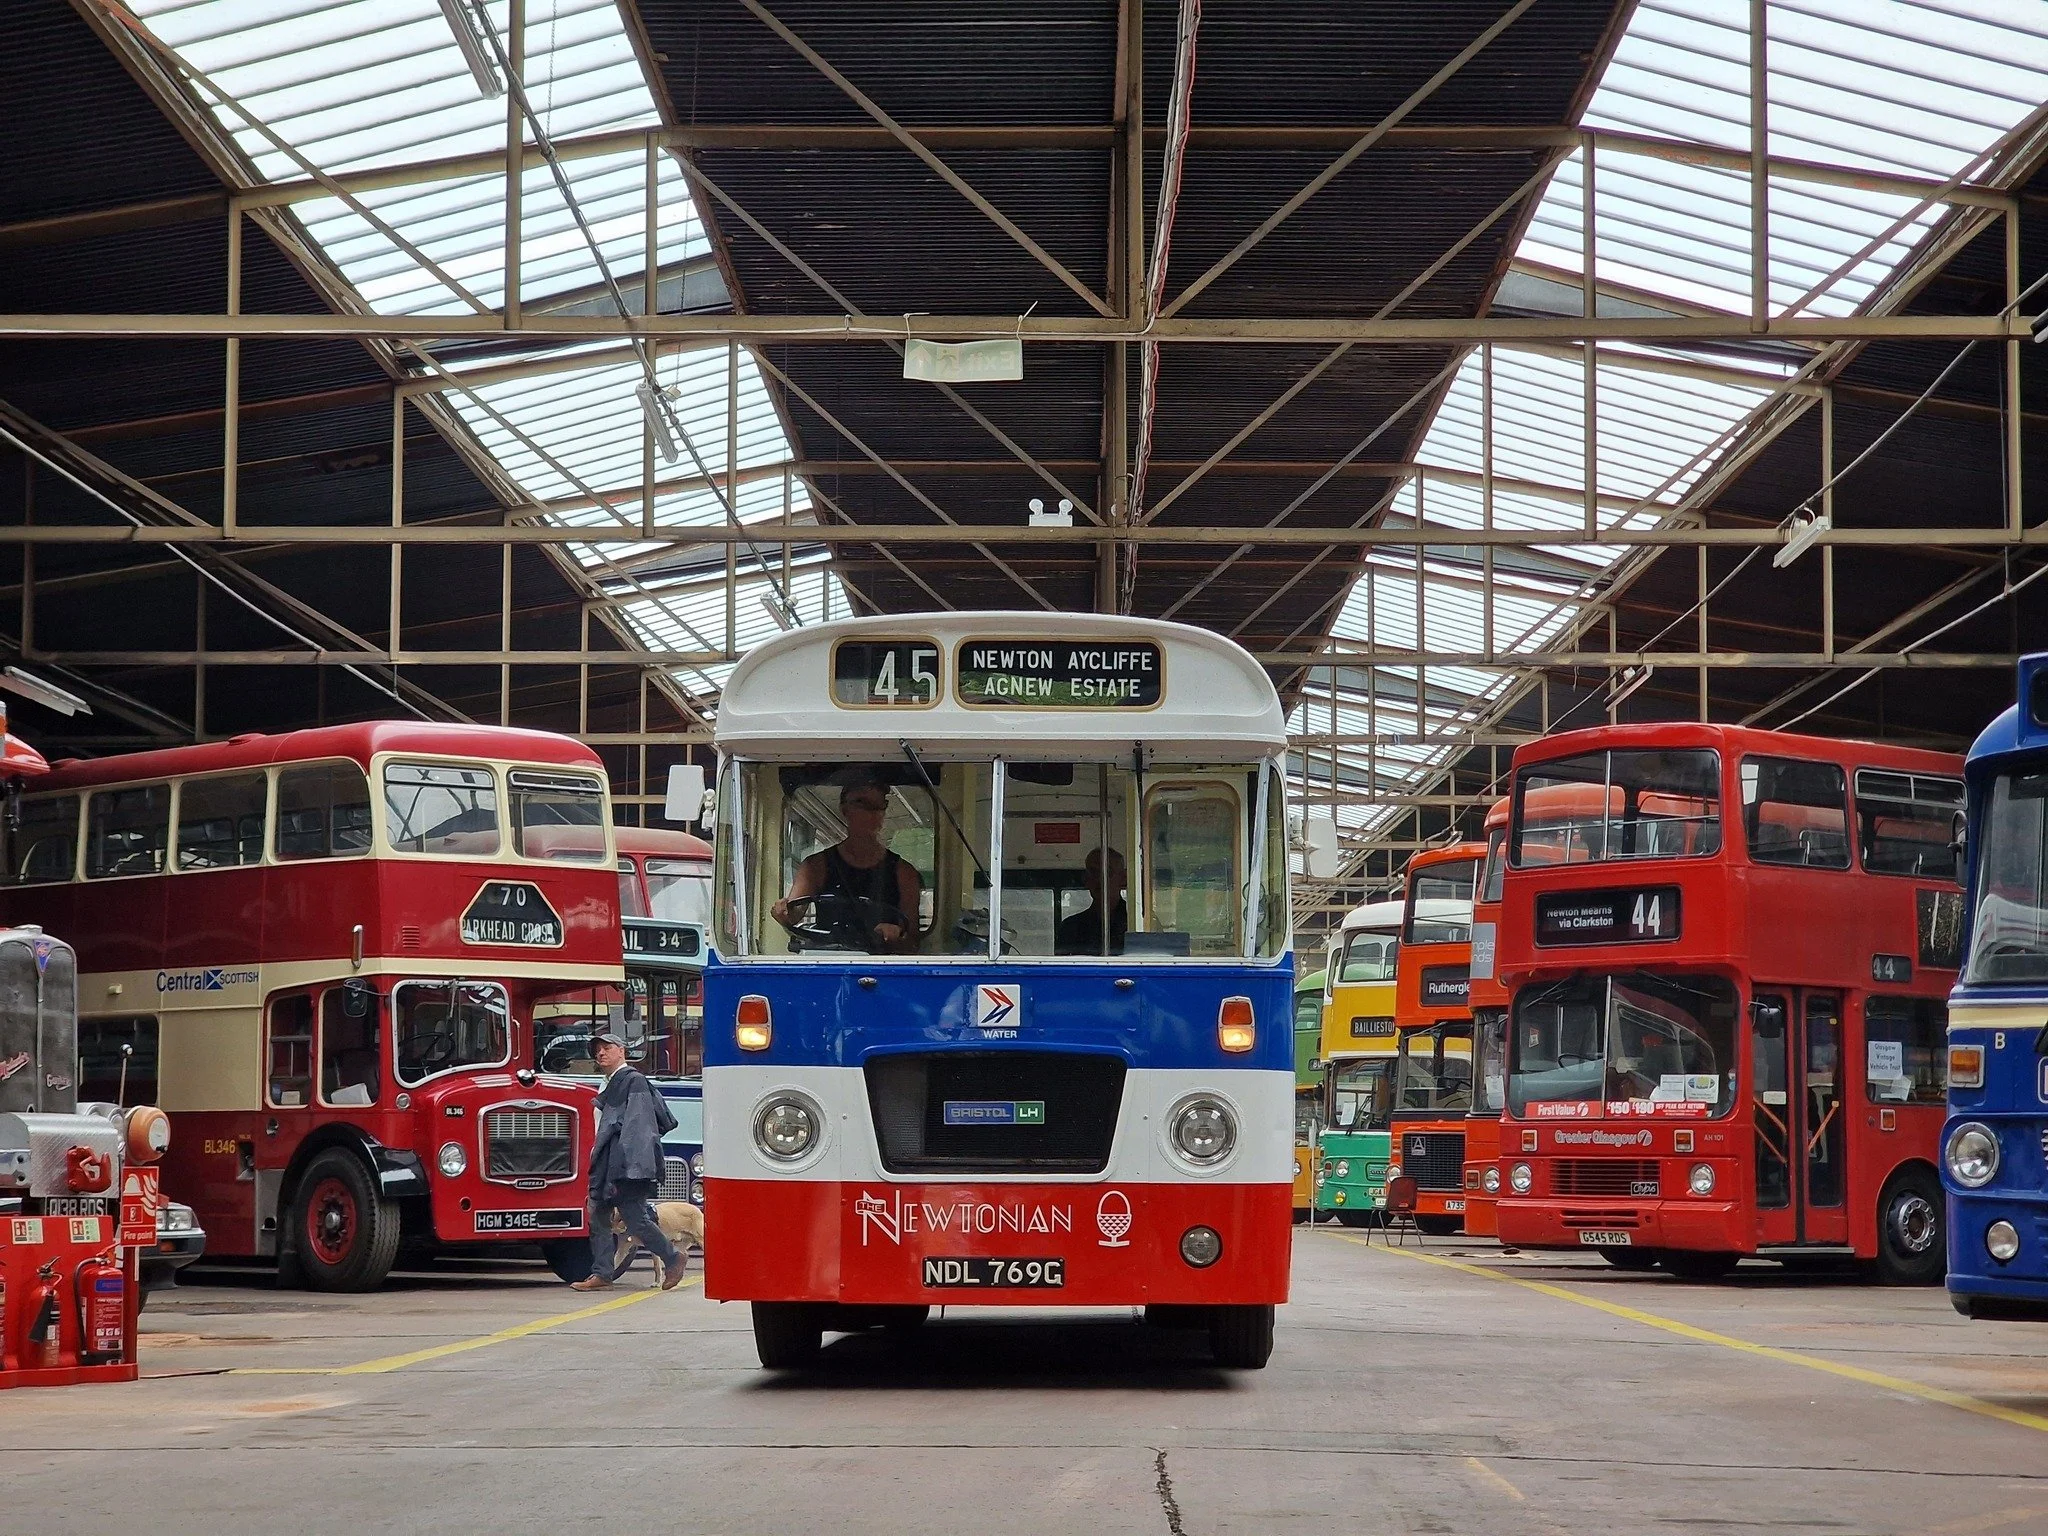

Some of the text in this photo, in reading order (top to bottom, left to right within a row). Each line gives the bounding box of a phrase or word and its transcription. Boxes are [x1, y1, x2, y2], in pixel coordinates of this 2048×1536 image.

[972, 649, 1153, 672] NEWTON AYCLIFFE
[873, 649, 938, 705] 45
[984, 677, 1142, 698] AGNEW ESTATE
[500, 886, 527, 907] 70
[1546, 905, 1613, 918] Newton Mearns
[1631, 893, 1661, 936] 44
[1558, 916, 1614, 928] via Clarkston
[658, 930, 681, 949] 34
[1873, 956, 1895, 979] 44
[156, 970, 259, 992] Central SCOTTISH
[983, 1030, 1018, 1039] WATER
[1994, 1032, 2006, 1050] B
[950, 1107, 1039, 1118] BRISTOL LH
[204, 1139, 236, 1154] BL346
[1554, 1129, 1637, 1148] Greater Glasgow
[859, 1201, 883, 1212] THE
[477, 1212, 537, 1228] HGM 346E
[123, 1231, 153, 1241] Fire point
[1582, 1231, 1627, 1244] G545 RDS
[925, 1260, 1063, 1285] NDL 769G
